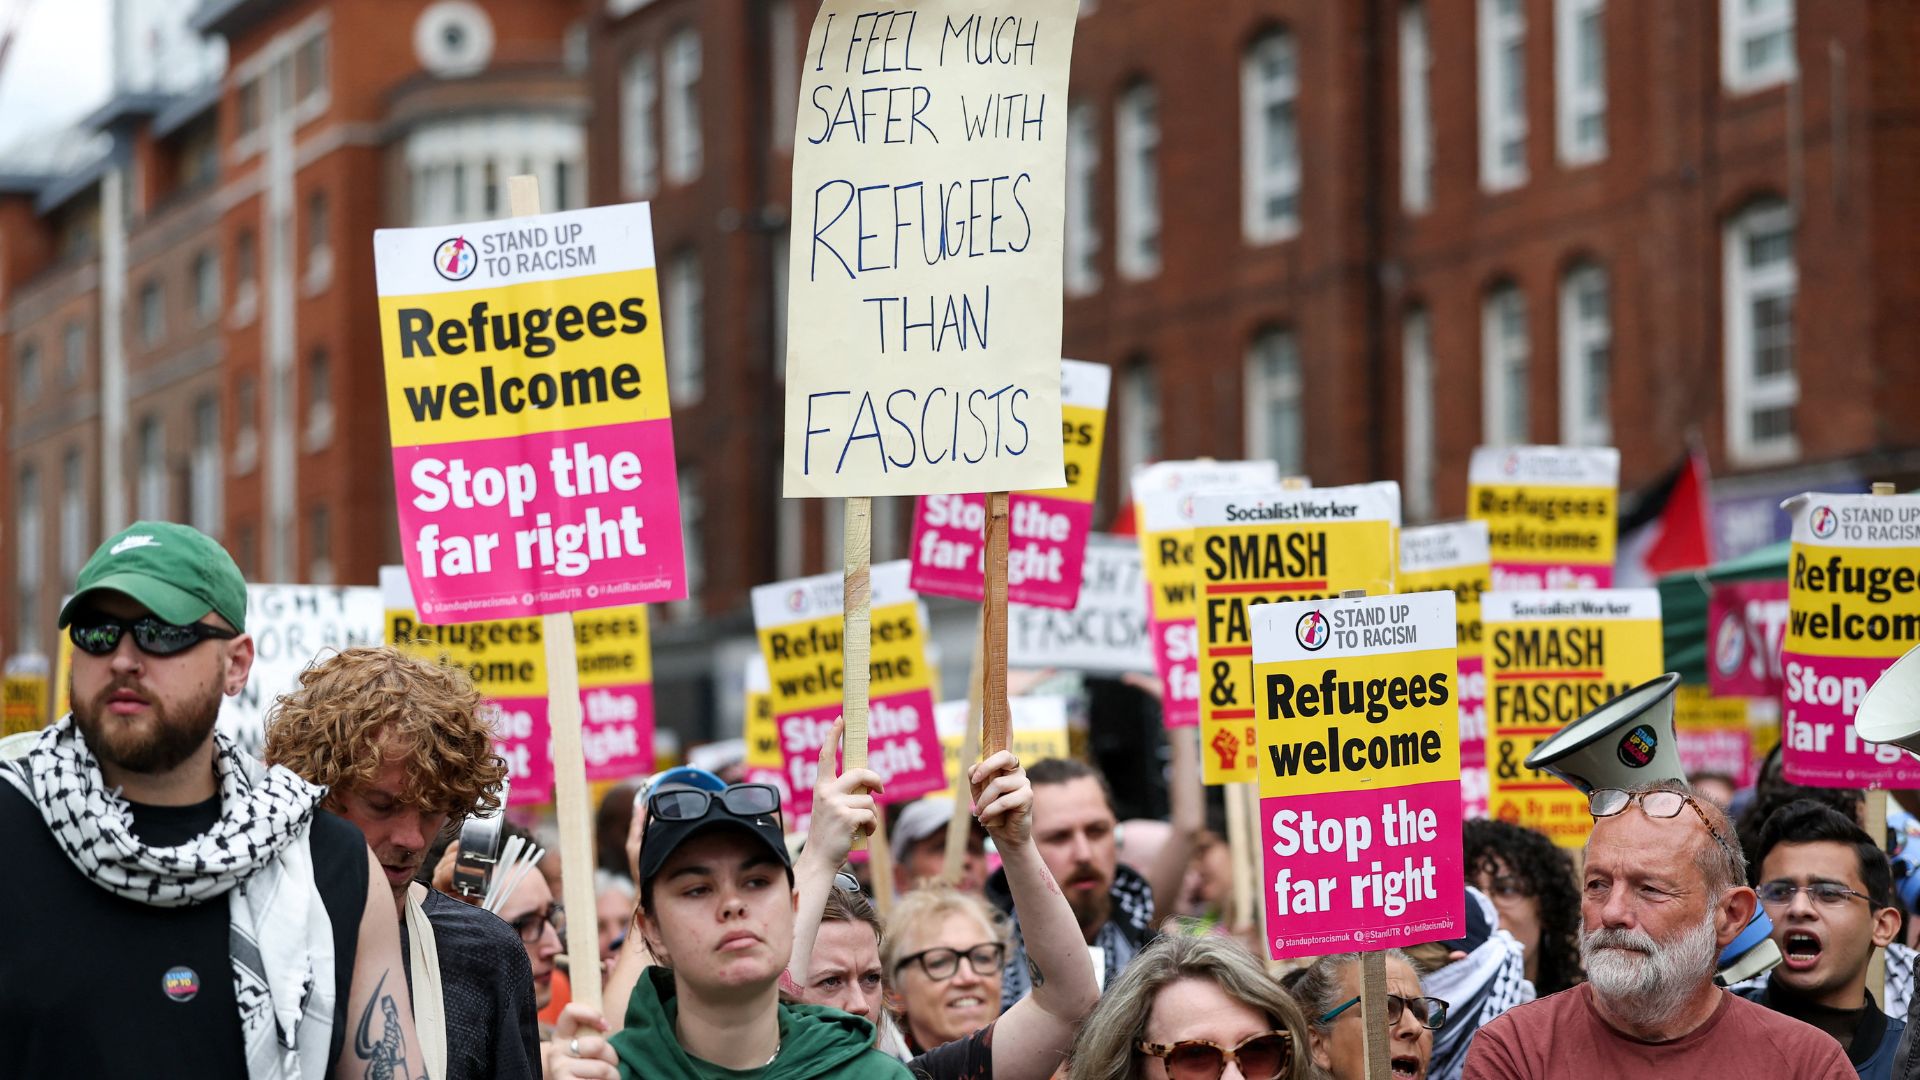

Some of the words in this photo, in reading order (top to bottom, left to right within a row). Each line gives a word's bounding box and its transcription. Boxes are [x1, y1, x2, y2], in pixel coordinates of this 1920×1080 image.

[816, 13, 836, 71] I
[846, 11, 922, 75] FEEL
[940, 14, 1038, 66] MUCH
[808, 85, 938, 144] SAFER
[961, 94, 1045, 141] WITH
[482, 228, 548, 254] STAND
[555, 224, 582, 245] UP
[812, 173, 1031, 281] REFUGEES
[485, 256, 510, 278] TO
[516, 245, 596, 274] RACISM
[397, 297, 647, 359] Refugees
[863, 285, 989, 353] THAN
[404, 363, 641, 422] welcome
[804, 385, 1029, 475] FASCISTS
[410, 457, 537, 518] Stop
[550, 442, 642, 497] the
[924, 494, 984, 540] Sto
[1012, 501, 1071, 542] the
[1226, 501, 1299, 521] Socialist
[1301, 500, 1359, 518] Worker
[1842, 507, 1894, 523] STAND
[1898, 507, 1920, 522] UP
[1843, 525, 1862, 540] TO
[416, 524, 499, 578] far
[515, 506, 646, 577] right
[920, 530, 974, 570] far
[1205, 532, 1327, 581] SMASH
[1794, 552, 1920, 604] Refuge
[770, 615, 913, 662] Refues
[1333, 606, 1386, 629] STAND
[1390, 604, 1410, 624] UP
[1335, 630, 1358, 650] TO
[1363, 624, 1418, 648] RACISM
[1493, 628, 1604, 668] SMASH
[777, 655, 913, 698] welcme
[1210, 660, 1238, 707] &
[1266, 669, 1449, 724] Refugees
[1786, 660, 1867, 716] Stop
[1496, 682, 1632, 724] FASCIS
[1268, 727, 1442, 777] welcome
[1630, 734, 1641, 744] UP
[1638, 741, 1649, 753] TO
[1635, 728, 1655, 747] STAND
[1786, 709, 1835, 752] far
[1497, 740, 1518, 779] &
[1272, 809, 1372, 862] Stop
[1382, 799, 1438, 847] the
[1275, 868, 1337, 916] far
[1350, 856, 1438, 917] right
[1286, 932, 1350, 947] standuptoracismuk
[1364, 927, 1401, 939] @StandUTR
